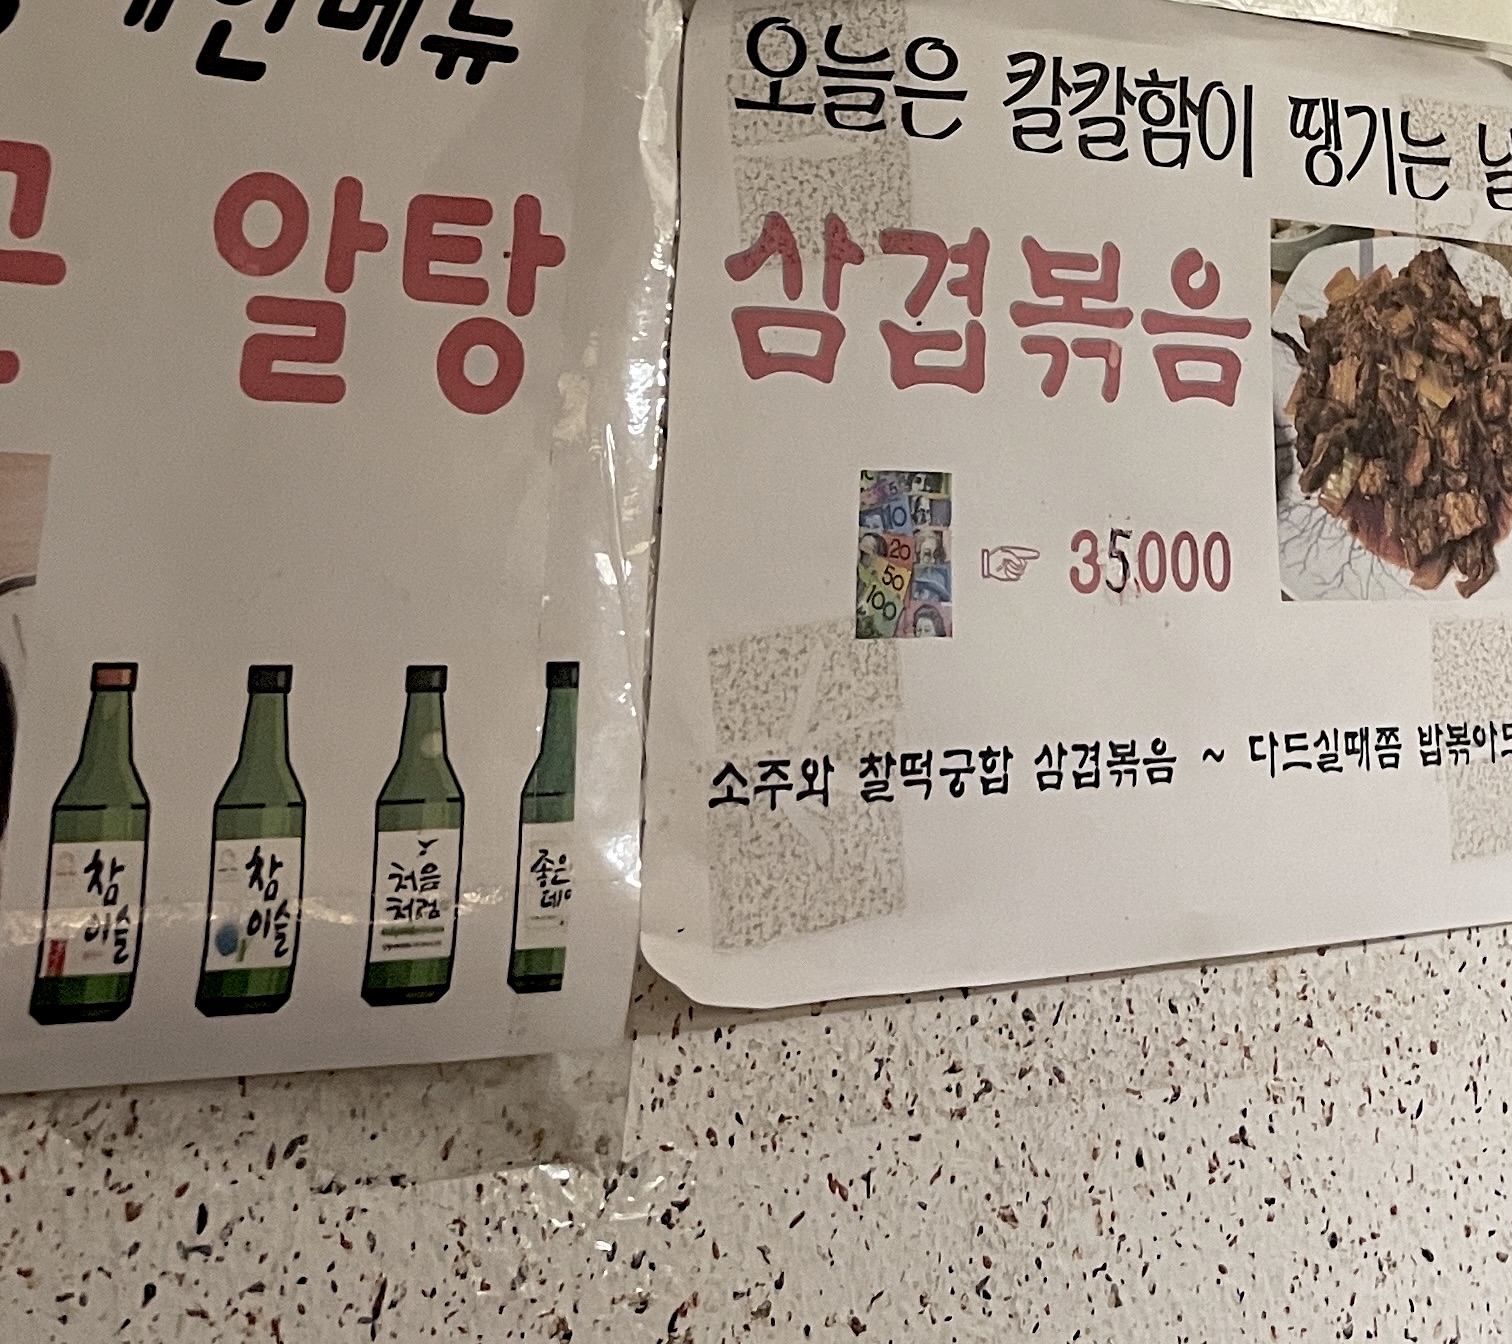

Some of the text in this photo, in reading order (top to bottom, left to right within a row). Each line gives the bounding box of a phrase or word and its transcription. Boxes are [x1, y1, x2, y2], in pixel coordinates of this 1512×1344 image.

[733, 16, 967, 140] 오늘은
[1002, 50, 1253, 178] 칼칼함이
[1287, 94, 1449, 201] 땡기는
[213, 171, 566, 415] 알탕
[723, 212, 1252, 405] 삼겹볶음
[709, 759, 833, 810] 소주와
[857, 746, 1014, 801] 찰떡궁합
[1034, 739, 1178, 793] 삼겹볶음
[1248, 721, 1402, 775] 다드실때쯤
[84, 849, 127, 906] 참
[245, 845, 283, 901] 참
[388, 862, 442, 892] 처음
[530, 849, 571, 888] 좋은
[247, 899, 291, 958] 이슬
[386, 897, 440, 922] 처럼
